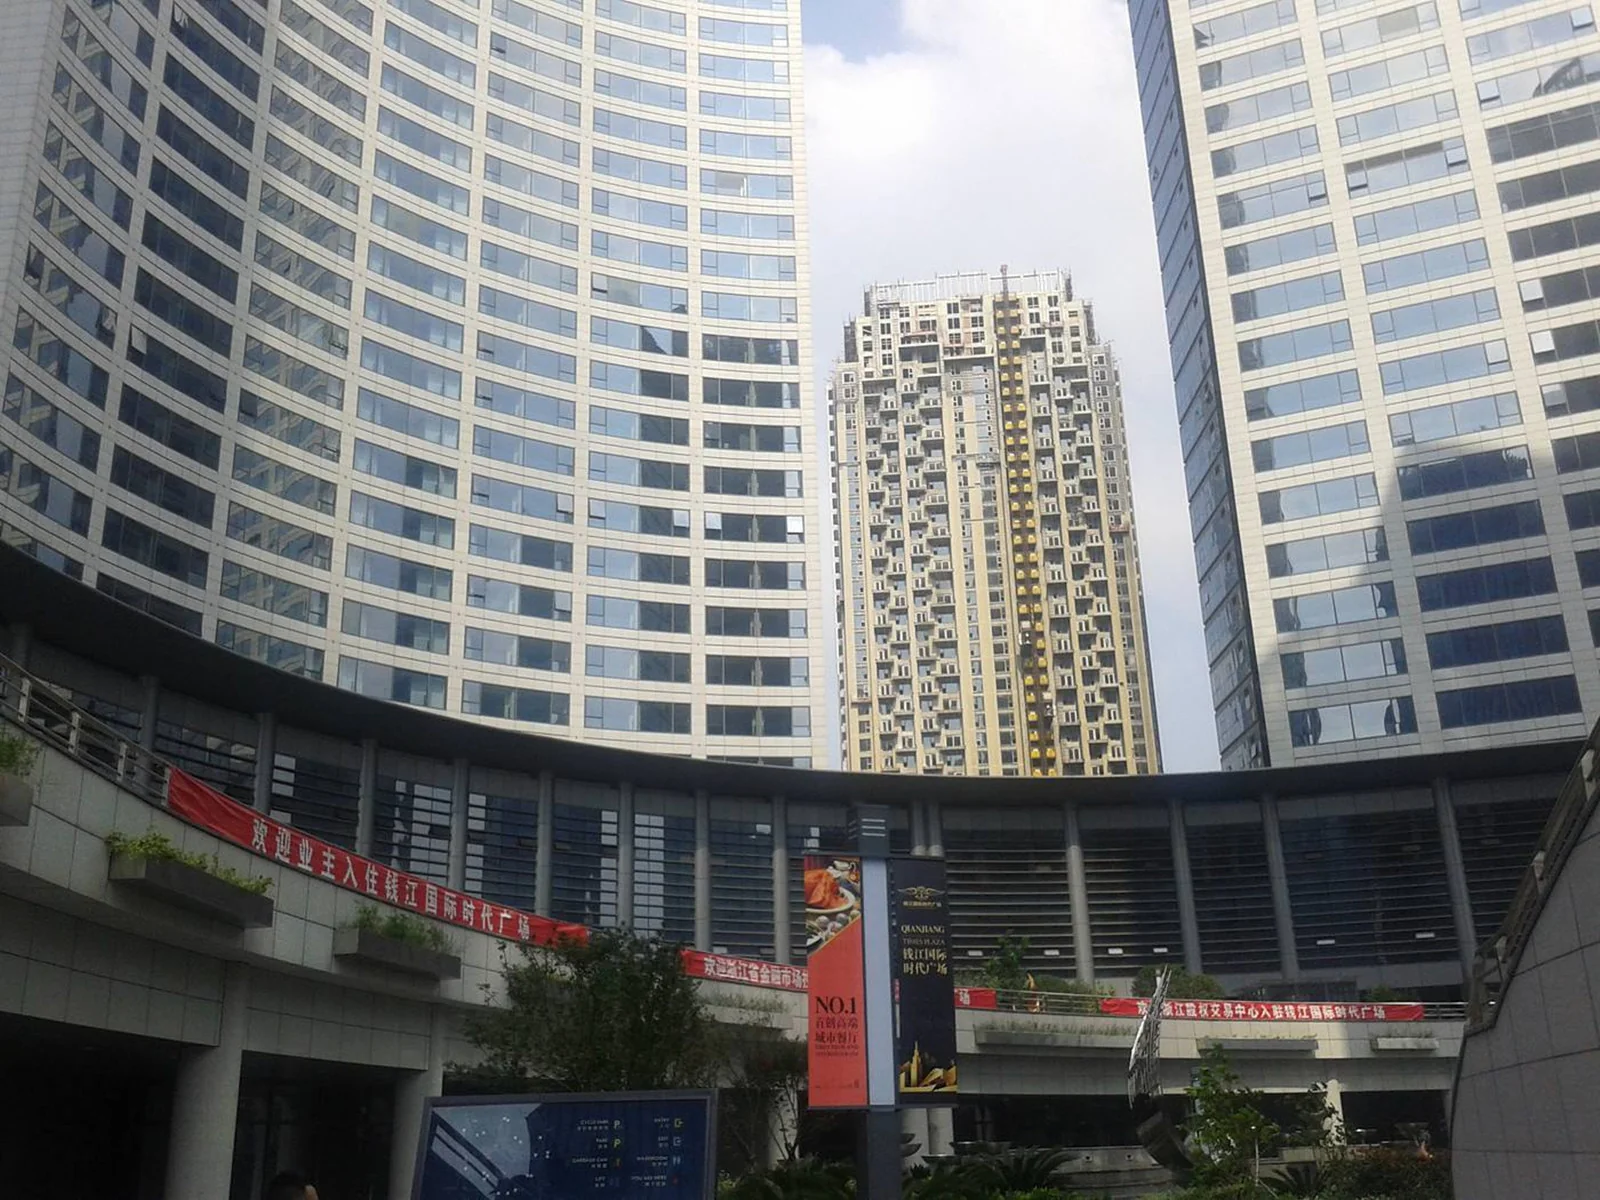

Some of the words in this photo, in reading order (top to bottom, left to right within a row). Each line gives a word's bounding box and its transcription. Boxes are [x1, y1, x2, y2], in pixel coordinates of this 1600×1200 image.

[250, 817, 531, 942] 欢迎业主入住钱江国际时代广场
[900, 923, 945, 934] QIANJIANG
[923, 938, 946, 946] PLAZA
[902, 947, 947, 961] 钱江国际
[902, 961, 948, 976] 时代广场
[815, 996, 857, 1014] NO.1
[1136, 1000, 1386, 1020] 欢浙江股权交易中心入驻钱江国际时代广场
